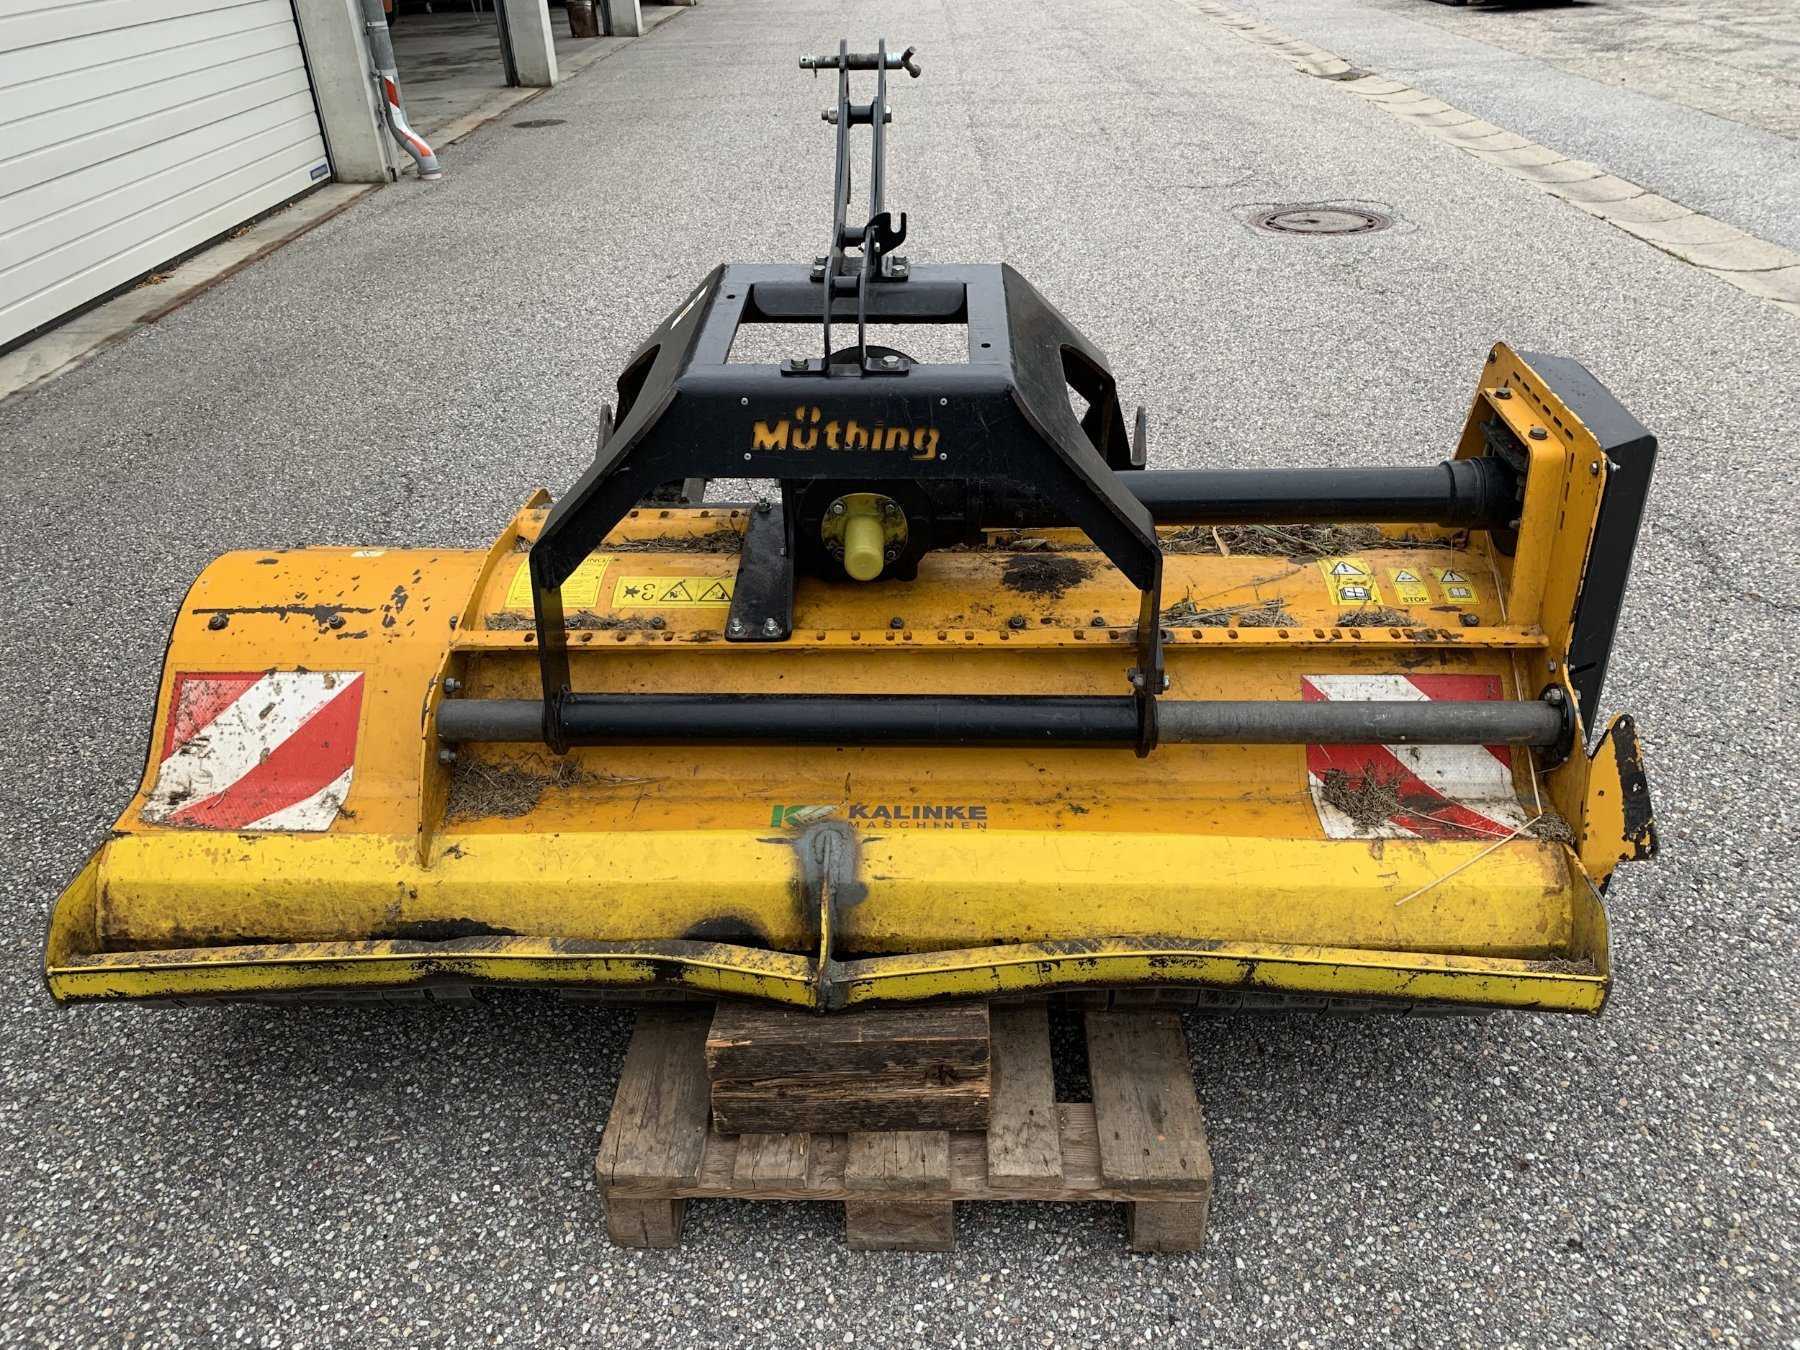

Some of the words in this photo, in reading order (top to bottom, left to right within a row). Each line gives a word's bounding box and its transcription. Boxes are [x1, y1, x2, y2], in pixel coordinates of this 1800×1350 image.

[752, 406, 940, 460] Müthing
[849, 805, 987, 820] KALINKE
[849, 821, 987, 830] MASCHINEN
